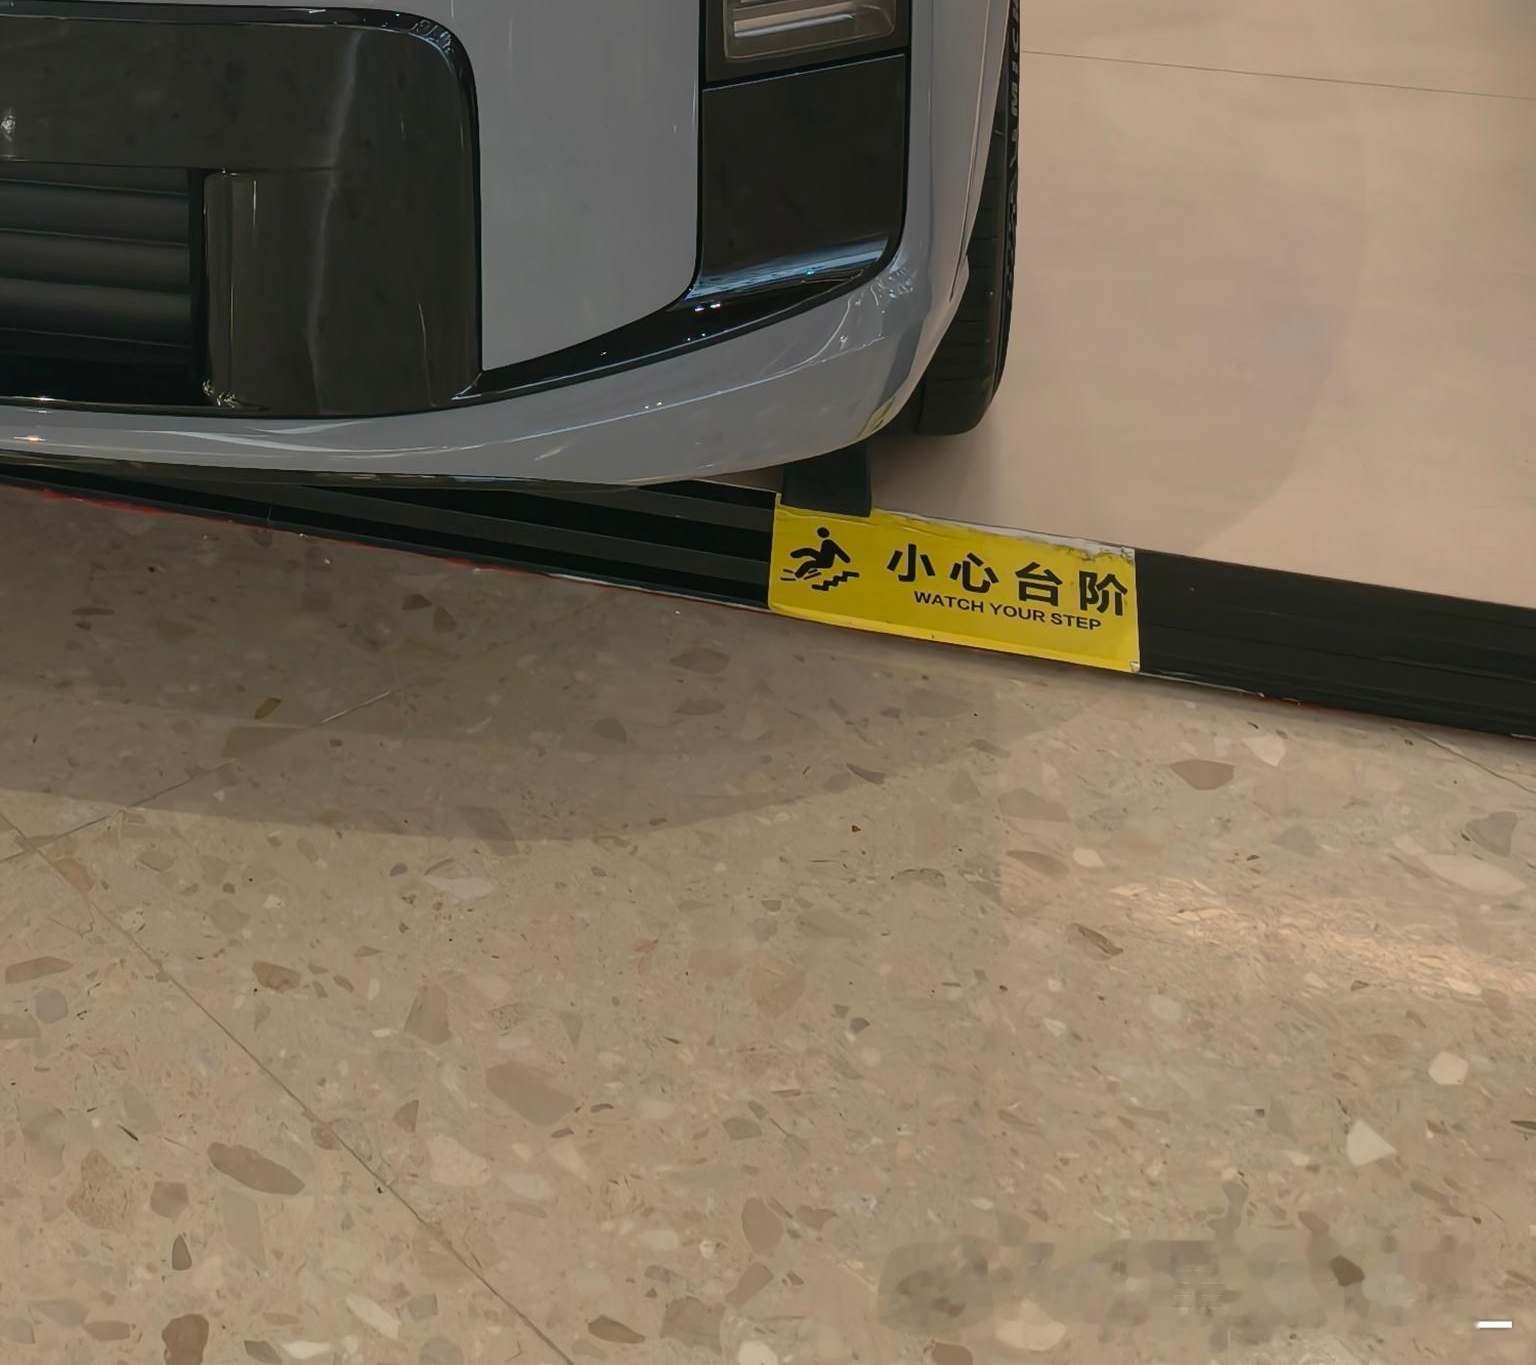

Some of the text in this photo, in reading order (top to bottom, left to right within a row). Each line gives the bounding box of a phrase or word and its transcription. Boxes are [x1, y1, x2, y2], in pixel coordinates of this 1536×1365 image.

[886, 543, 1129, 616] 小心台阶
[914, 590, 1103, 631] WATCH YOUR STEP
